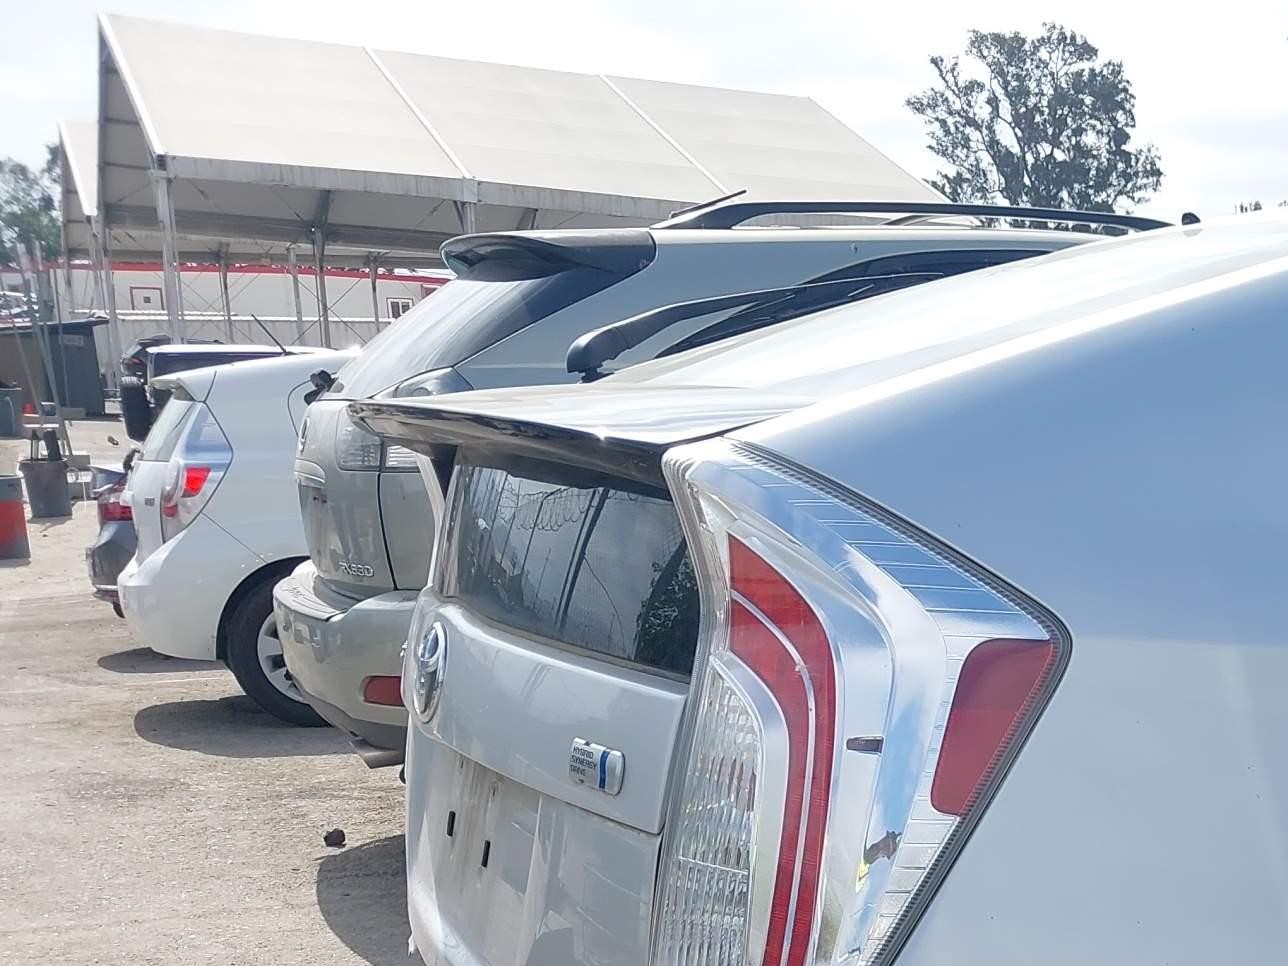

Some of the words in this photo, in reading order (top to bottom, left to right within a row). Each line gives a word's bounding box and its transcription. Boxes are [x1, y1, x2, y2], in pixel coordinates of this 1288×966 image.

[573, 746, 593, 759] HYBRID
[571, 755, 597, 770] SYNERGY
[570, 764, 586, 777] DRIVE
